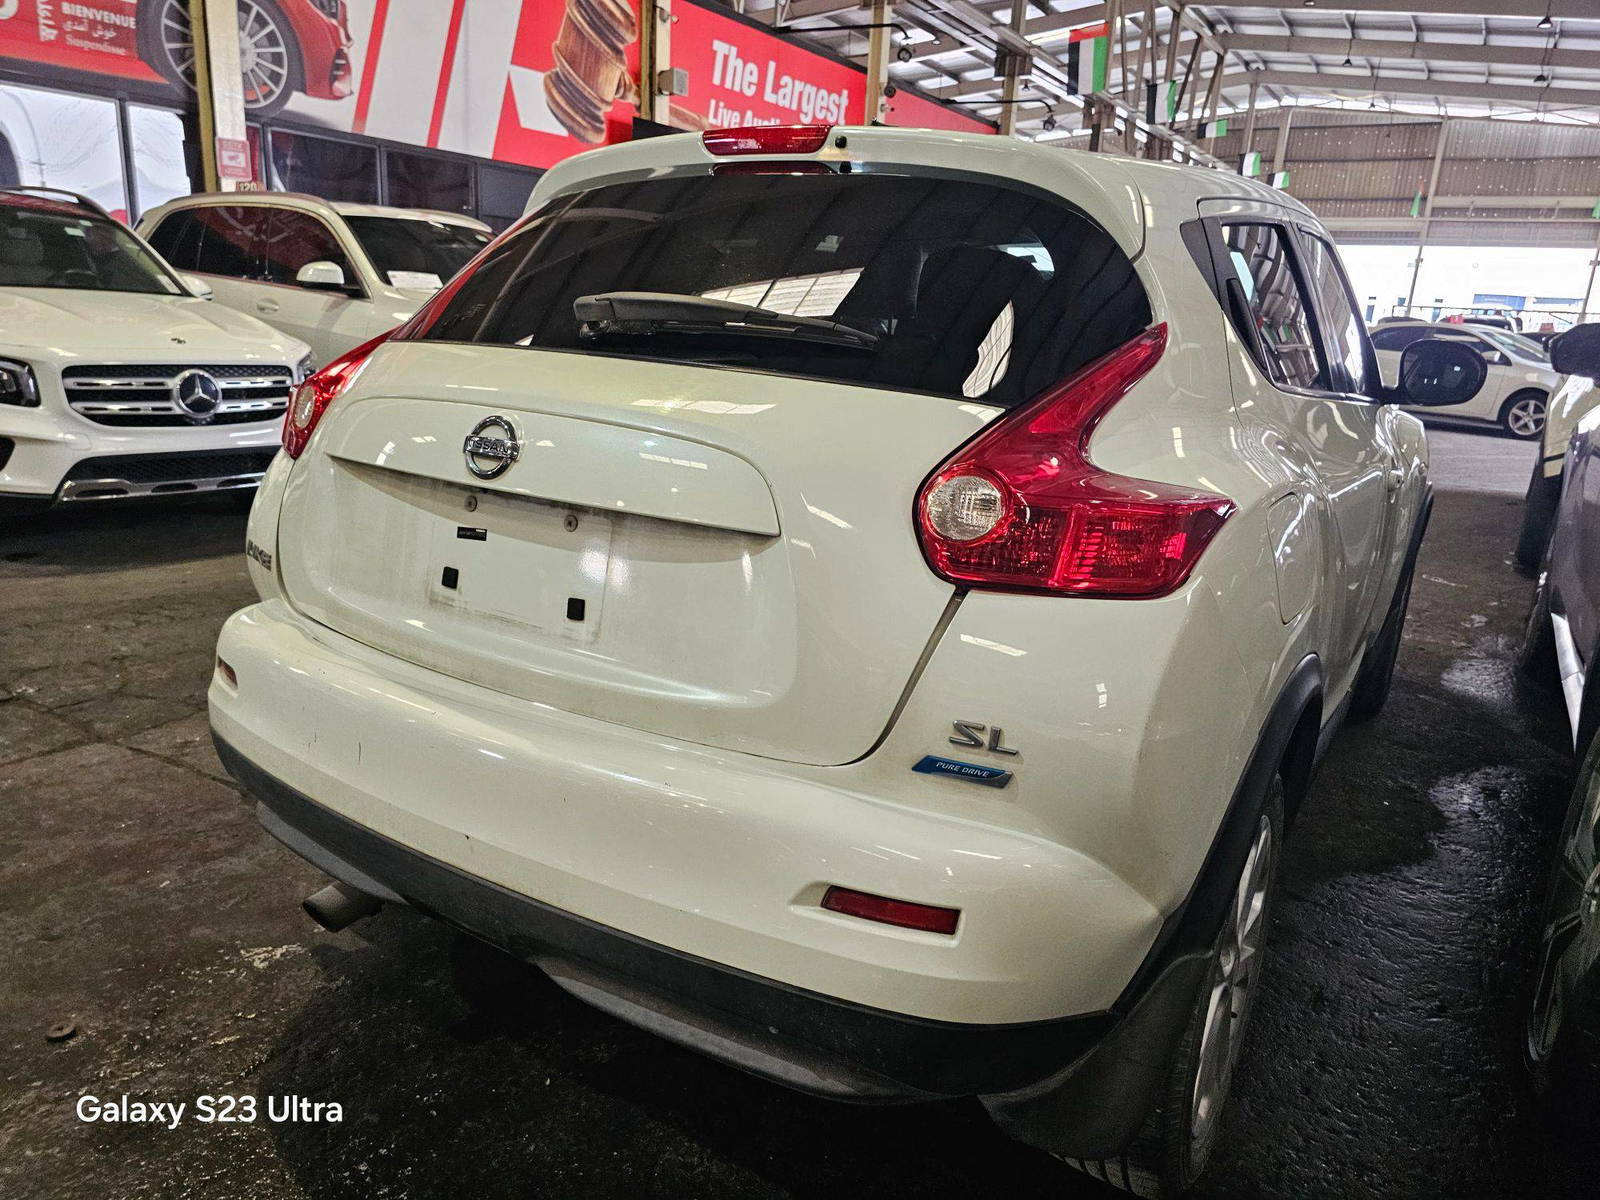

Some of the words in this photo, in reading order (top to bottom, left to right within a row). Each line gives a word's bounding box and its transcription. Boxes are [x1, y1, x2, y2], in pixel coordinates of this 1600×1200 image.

[61, 2, 137, 29] BIENVENUE
[712, 39, 759, 97] The
[764, 60, 849, 125] Largest
[708, 98, 740, 128] Live
[948, 719, 1019, 756] SL
[936, 761, 961, 773] PURE
[961, 766, 991, 778] DRIVE
